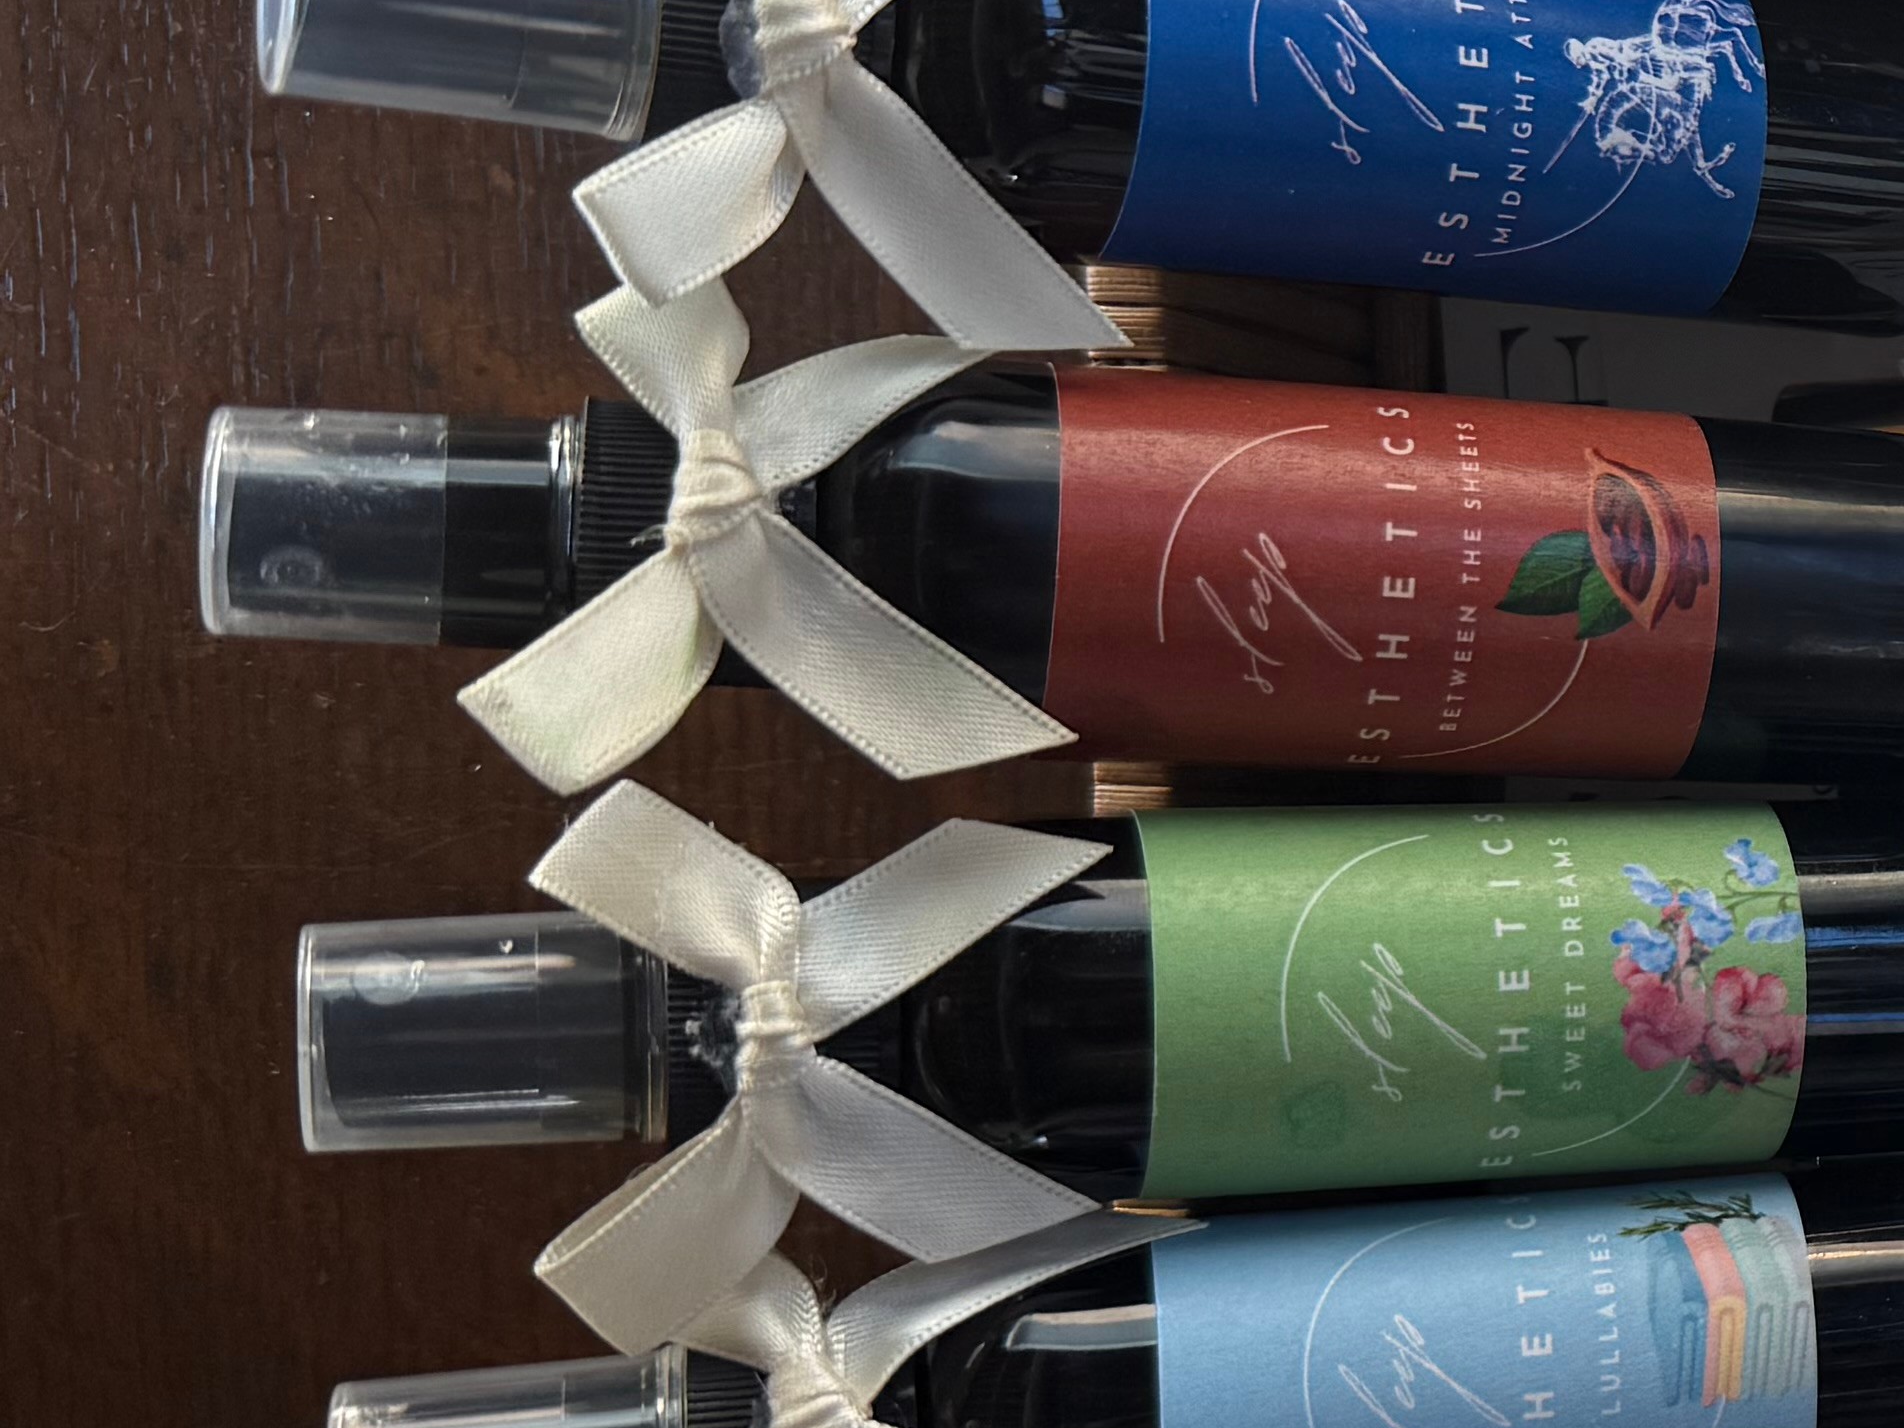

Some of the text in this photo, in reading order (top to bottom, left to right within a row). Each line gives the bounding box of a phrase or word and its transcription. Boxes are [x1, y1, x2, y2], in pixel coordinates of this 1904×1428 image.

[1491, 71, 1536, 244] MIDNIGHT
[1196, 531, 1363, 695] sleep
[1348, 406, 1417, 764] ESTHETICS
[1438, 421, 1482, 733] BETWEEN THE SHEETS
[1318, 942, 1487, 1102] sleep
[1471, 812, 1531, 1167] ESTHETICS
[1550, 834, 1588, 1092] SWEET DREAMS
[1588, 1232, 1622, 1415] LULLABIES
